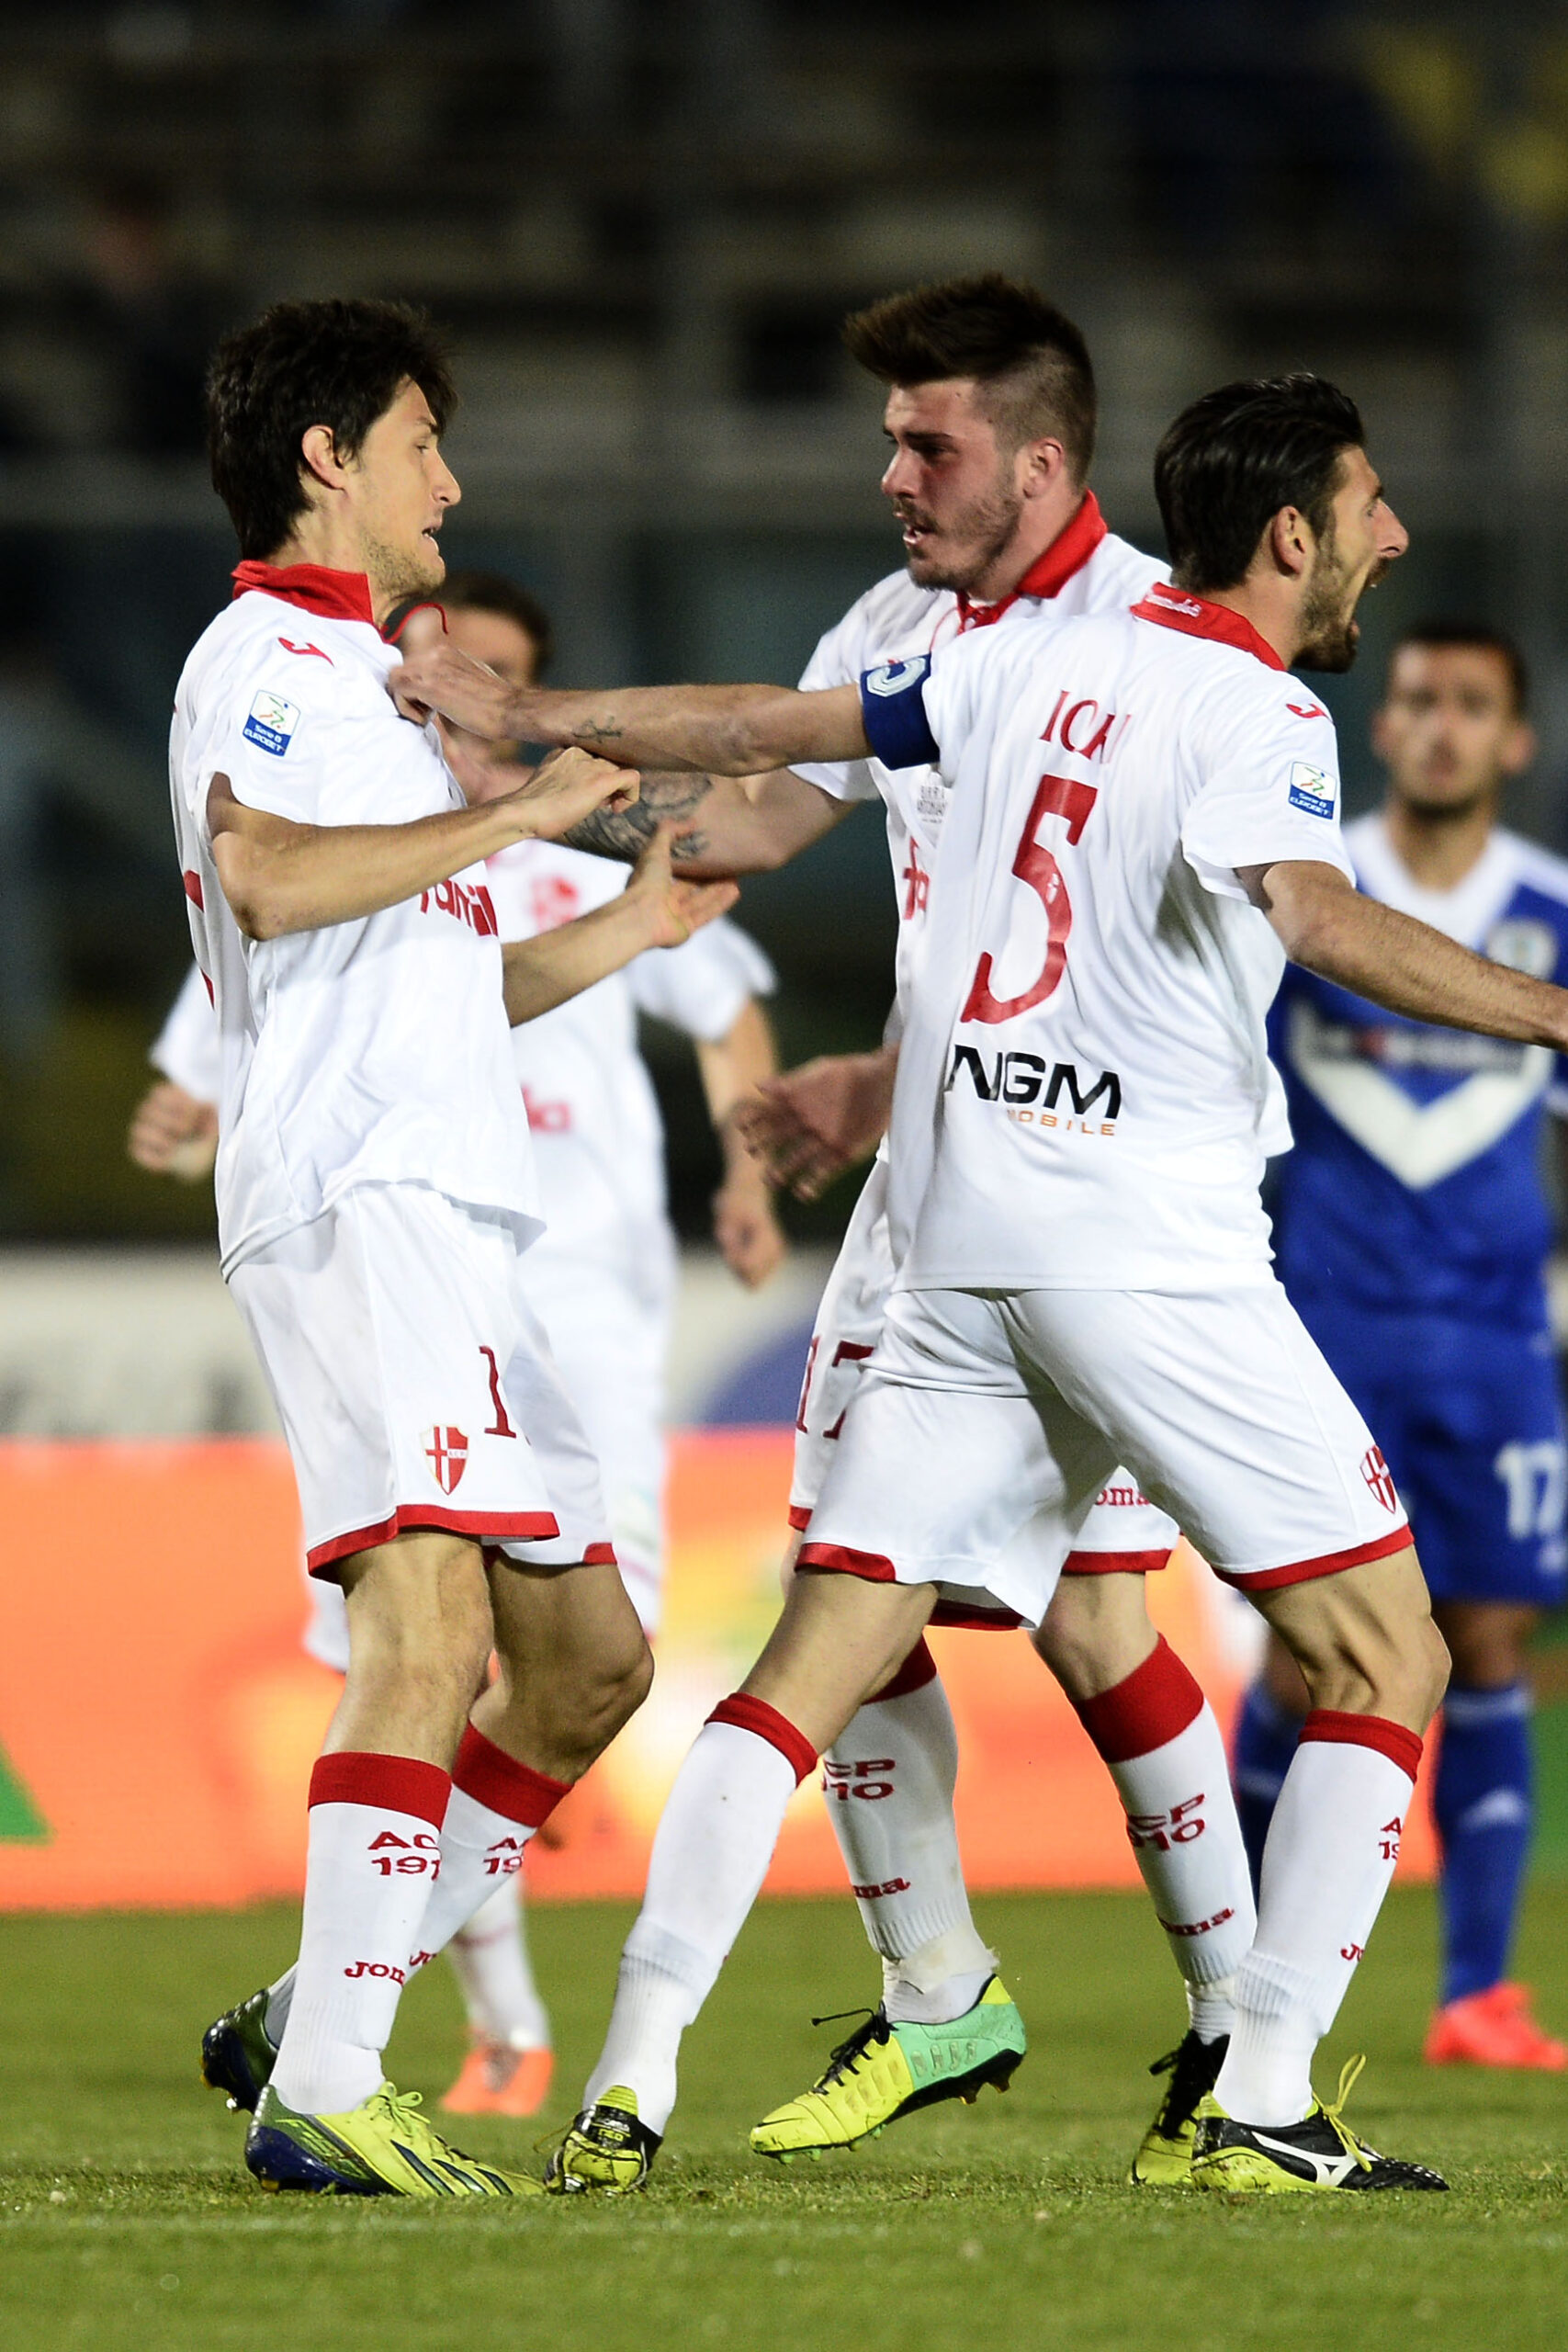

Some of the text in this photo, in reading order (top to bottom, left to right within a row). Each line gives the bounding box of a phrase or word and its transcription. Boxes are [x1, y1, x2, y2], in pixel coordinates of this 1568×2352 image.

[960, 774, 1098, 1025] 5
[946, 1044, 1122, 1120] NGM
[479, 1344, 517, 1440] 1
[1492, 1441, 1565, 1538] 17
[821, 1774, 895, 1801] 10
